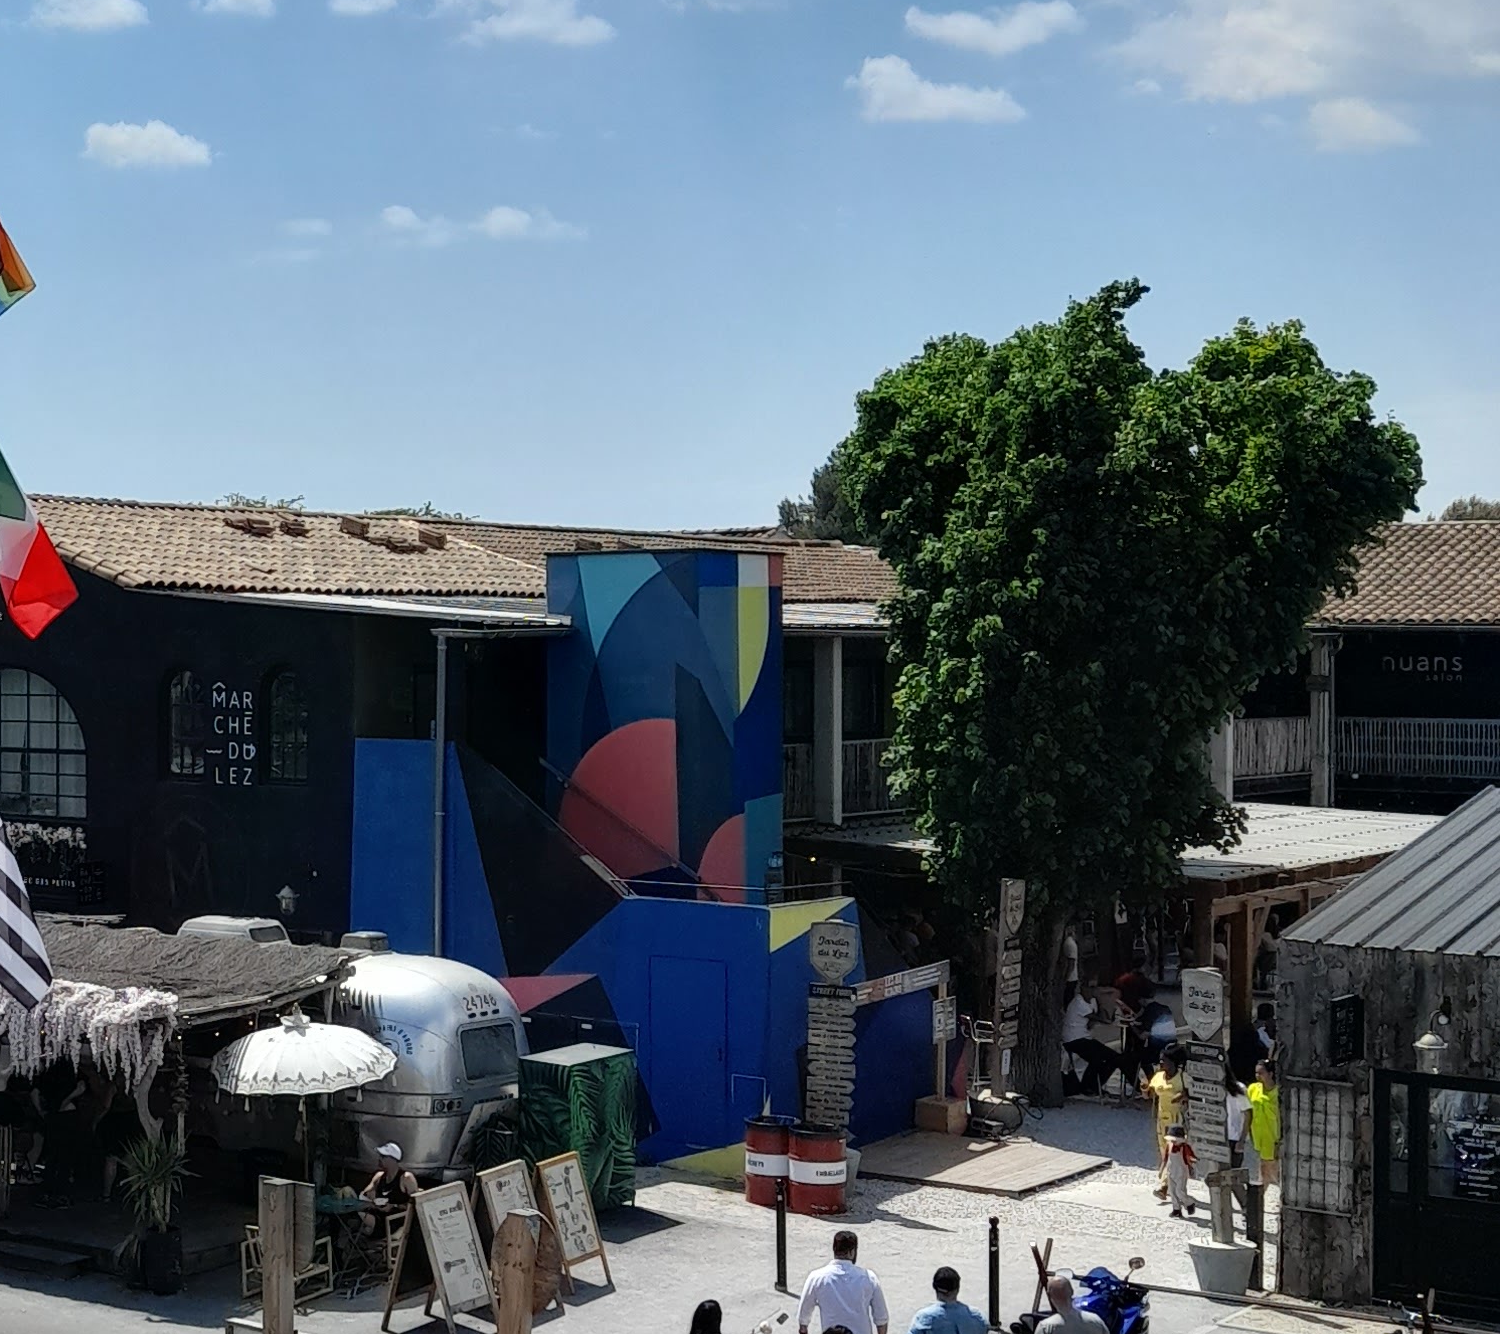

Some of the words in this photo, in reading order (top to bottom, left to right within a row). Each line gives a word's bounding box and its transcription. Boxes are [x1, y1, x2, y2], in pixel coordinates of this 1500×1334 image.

[1382, 656, 1463, 672] nuans
[212, 690, 253, 709] MAR
[215, 766, 253, 786] LEZ
[817, 935, 850, 947] Jardin
[1188, 986, 1216, 1000] Jardin
